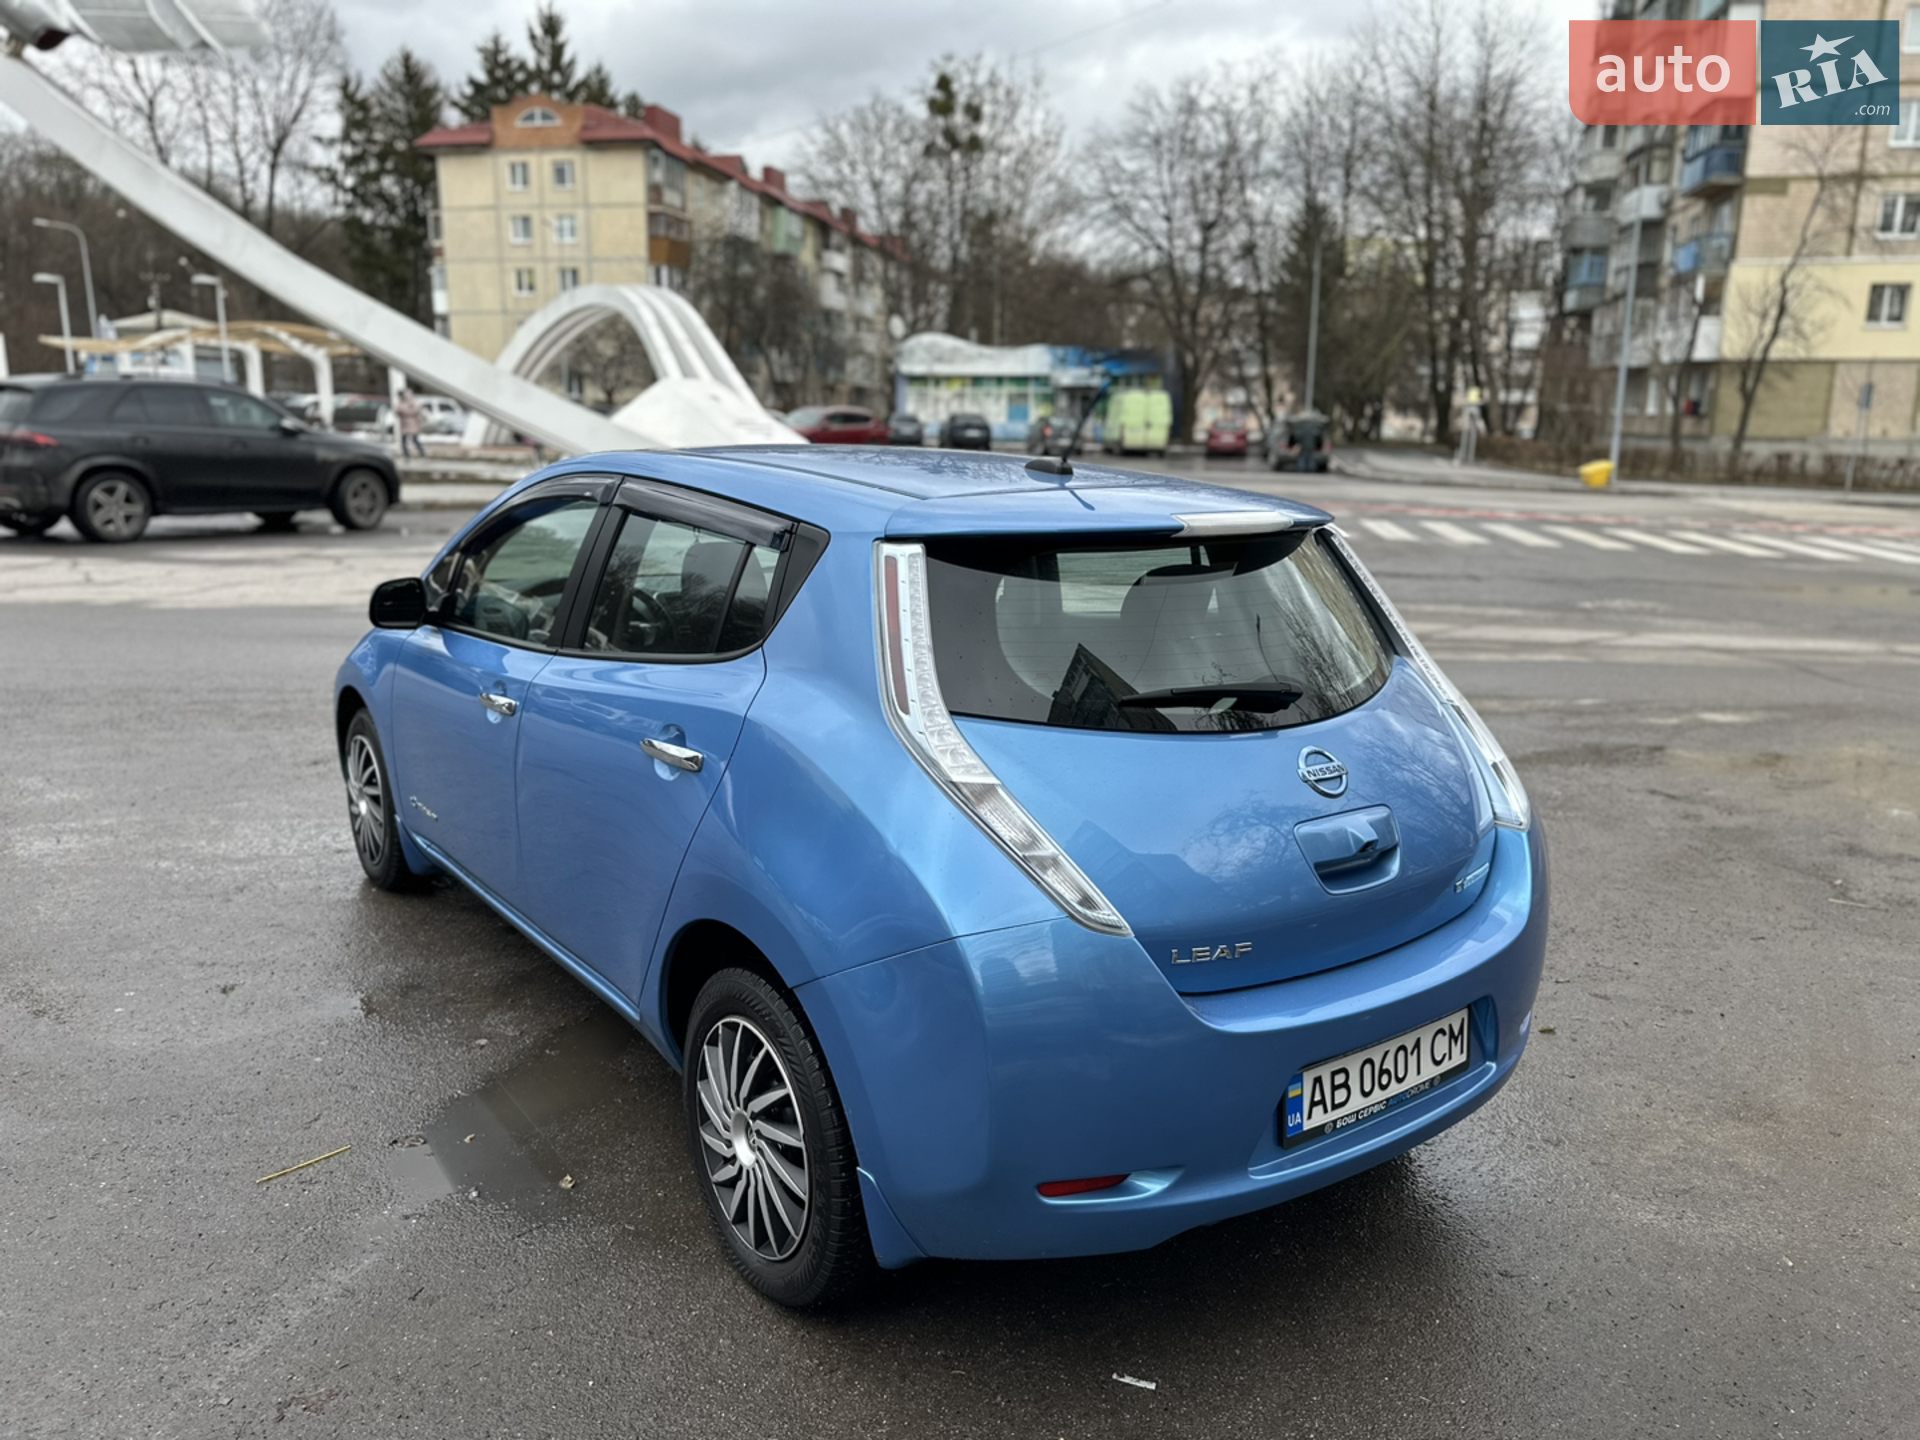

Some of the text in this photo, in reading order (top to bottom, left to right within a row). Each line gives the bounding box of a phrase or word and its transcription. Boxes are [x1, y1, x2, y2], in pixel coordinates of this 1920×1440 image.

[1306, 763, 1345, 778] NISSAN
[1171, 942, 1252, 964] LEAF
[1306, 1016, 1465, 1121] AB 0601 CM
[1287, 1113, 1302, 1127] UA
[1336, 1114, 1357, 1128] БОШ
